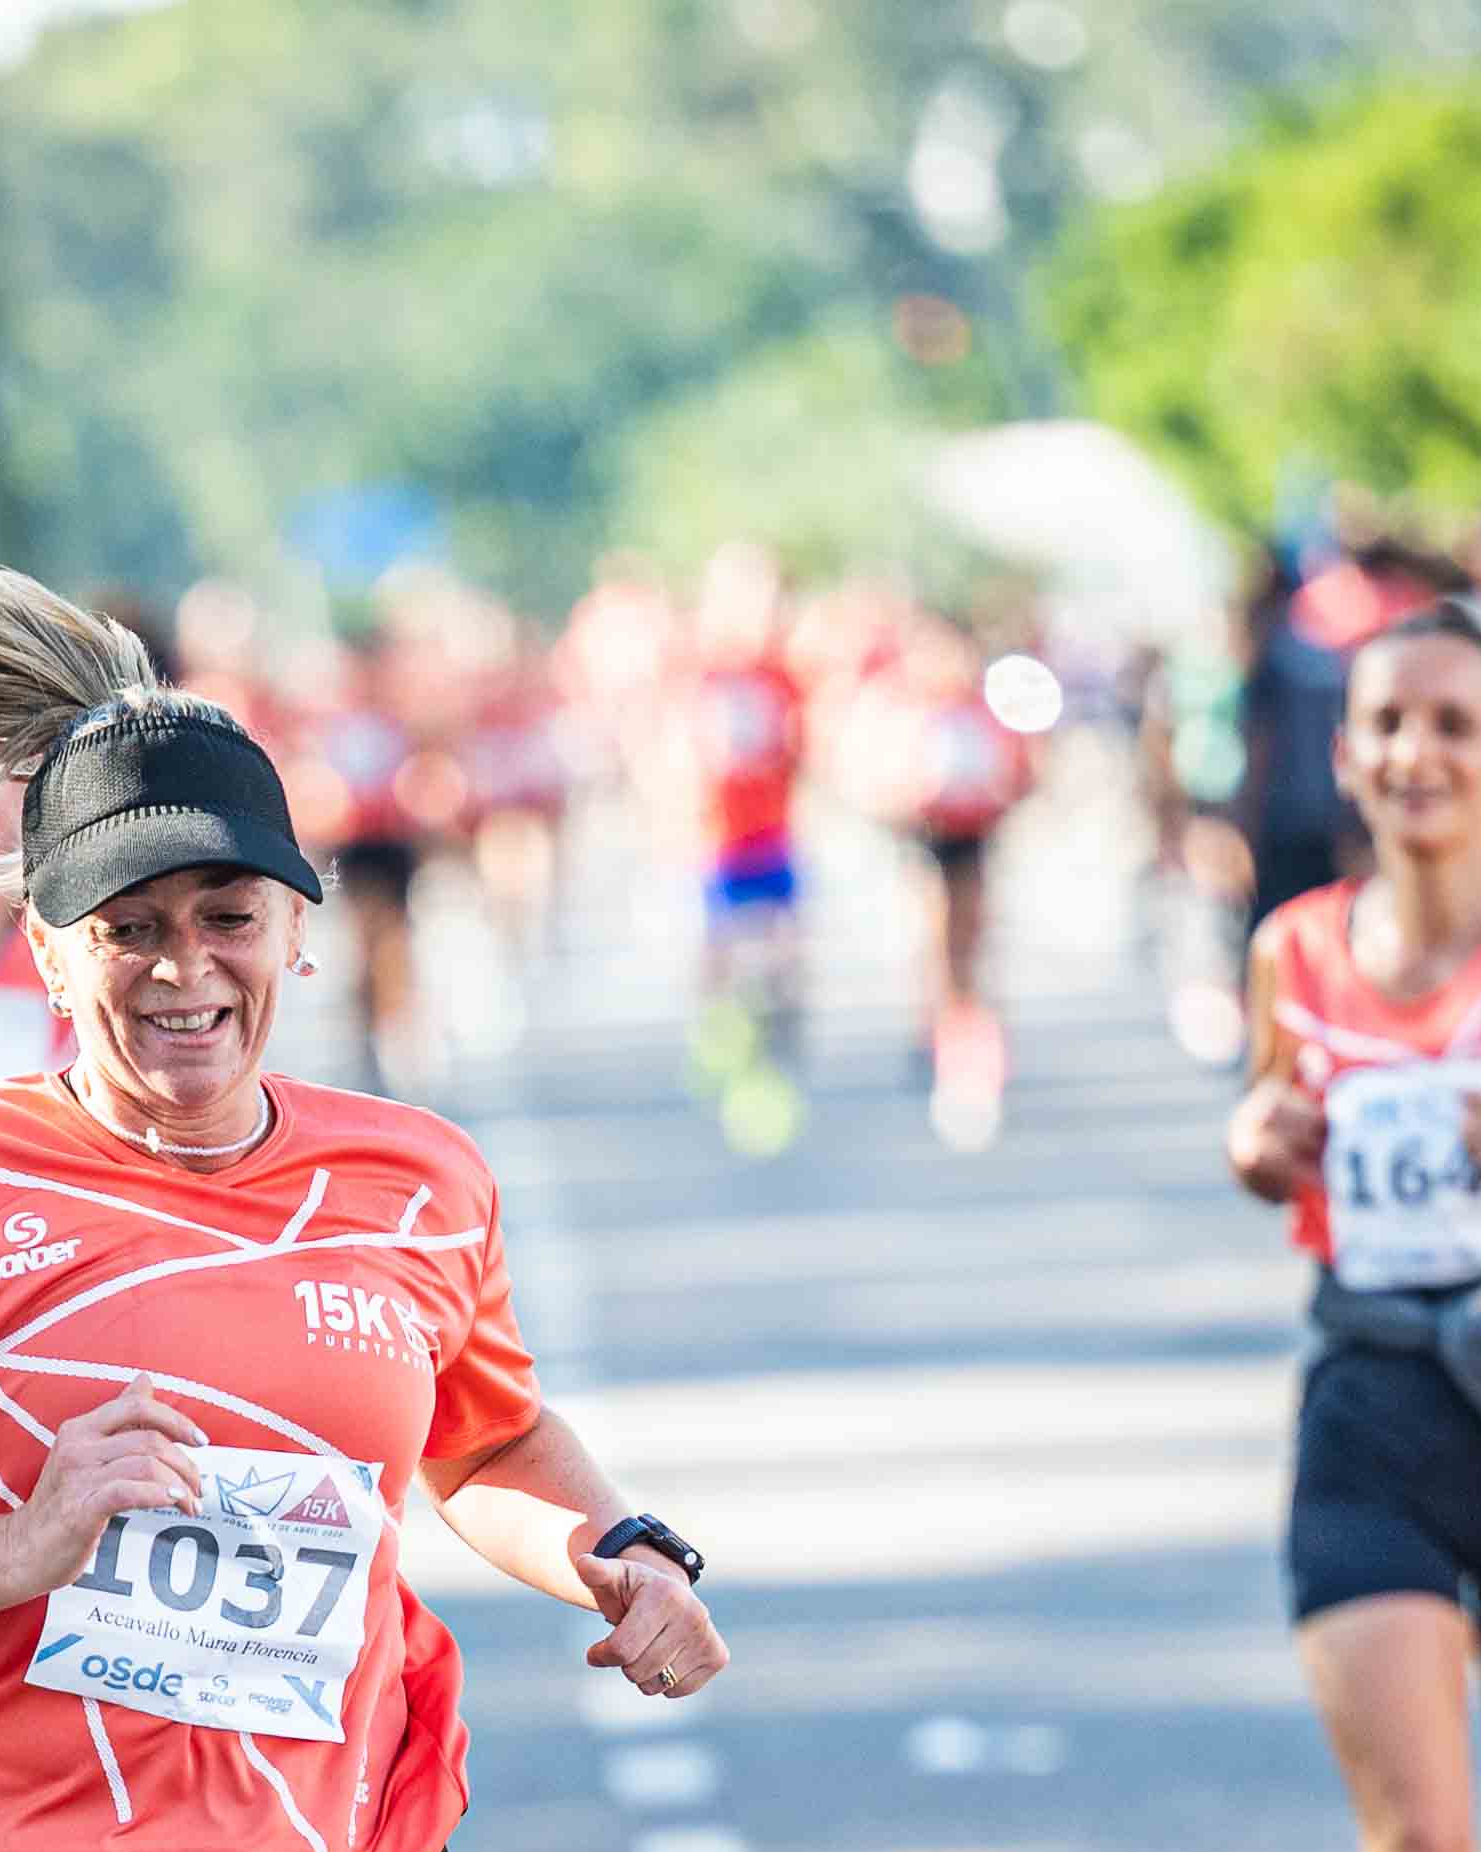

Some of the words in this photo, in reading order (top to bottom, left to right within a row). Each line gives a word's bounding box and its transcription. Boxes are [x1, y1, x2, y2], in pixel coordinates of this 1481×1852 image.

[294, 1280, 393, 1340] 15K
[301, 1498, 338, 1520] 15K
[71, 1514, 358, 1639] 1037
[87, 1606, 181, 1641] Accavallo
[241, 1639, 319, 1665] Florencia
[81, 1654, 183, 1697] osde
